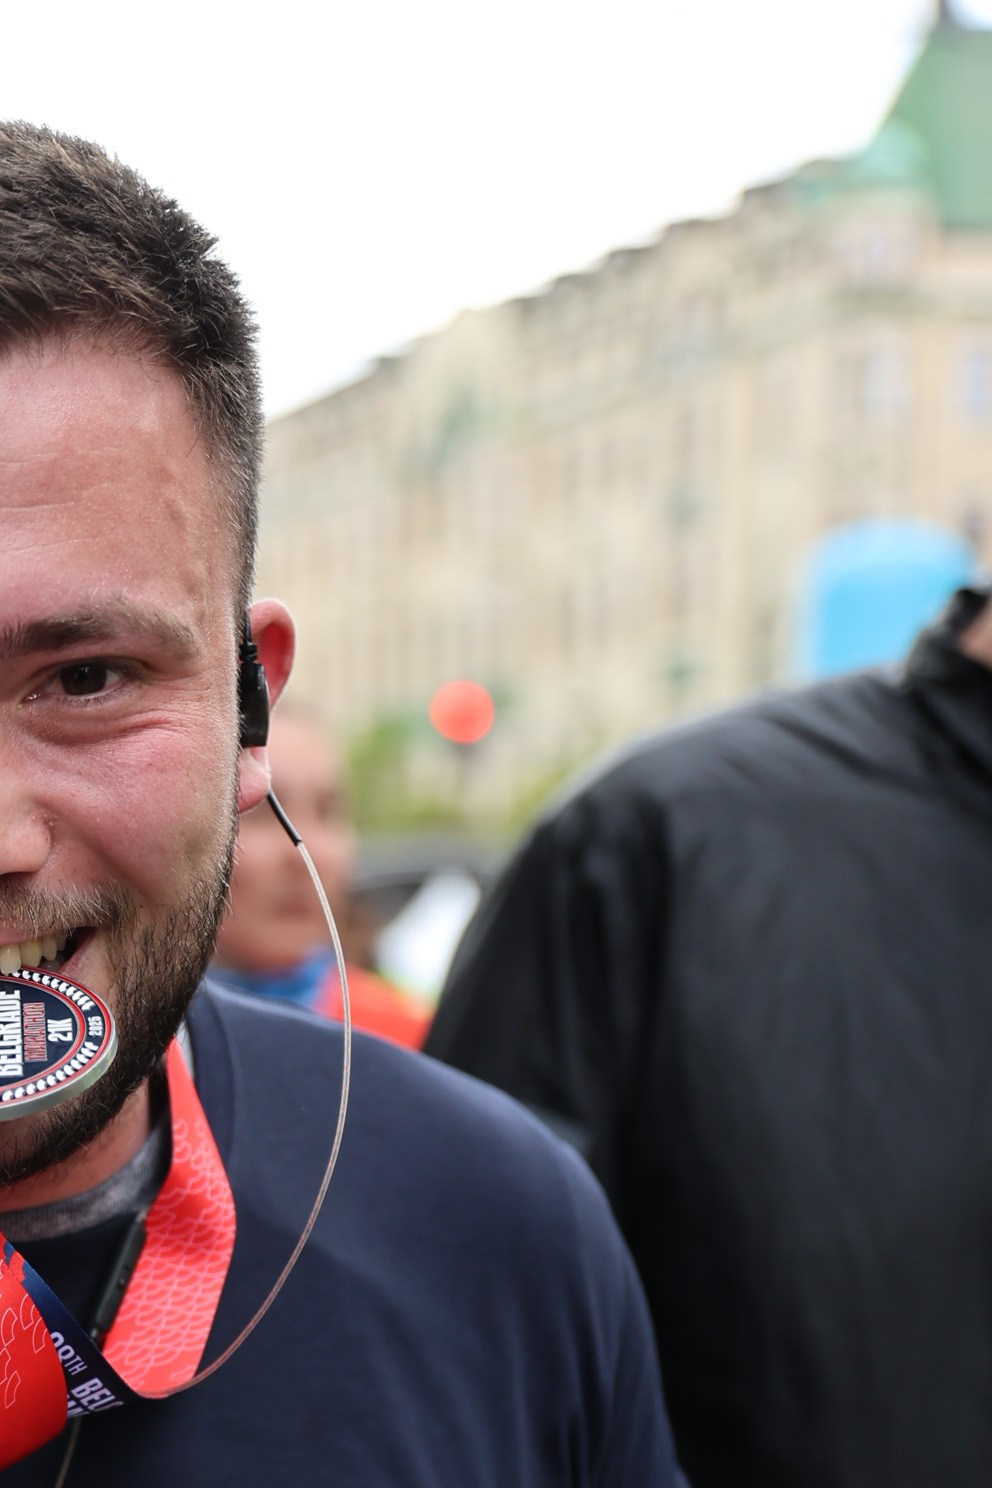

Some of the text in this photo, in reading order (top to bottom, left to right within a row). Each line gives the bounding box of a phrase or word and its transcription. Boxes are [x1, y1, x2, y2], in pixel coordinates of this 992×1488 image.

[22, 1002, 47, 1062] MARATHON
[47, 1017, 73, 1042] 21K
[88, 1015, 103, 1037] 2025
